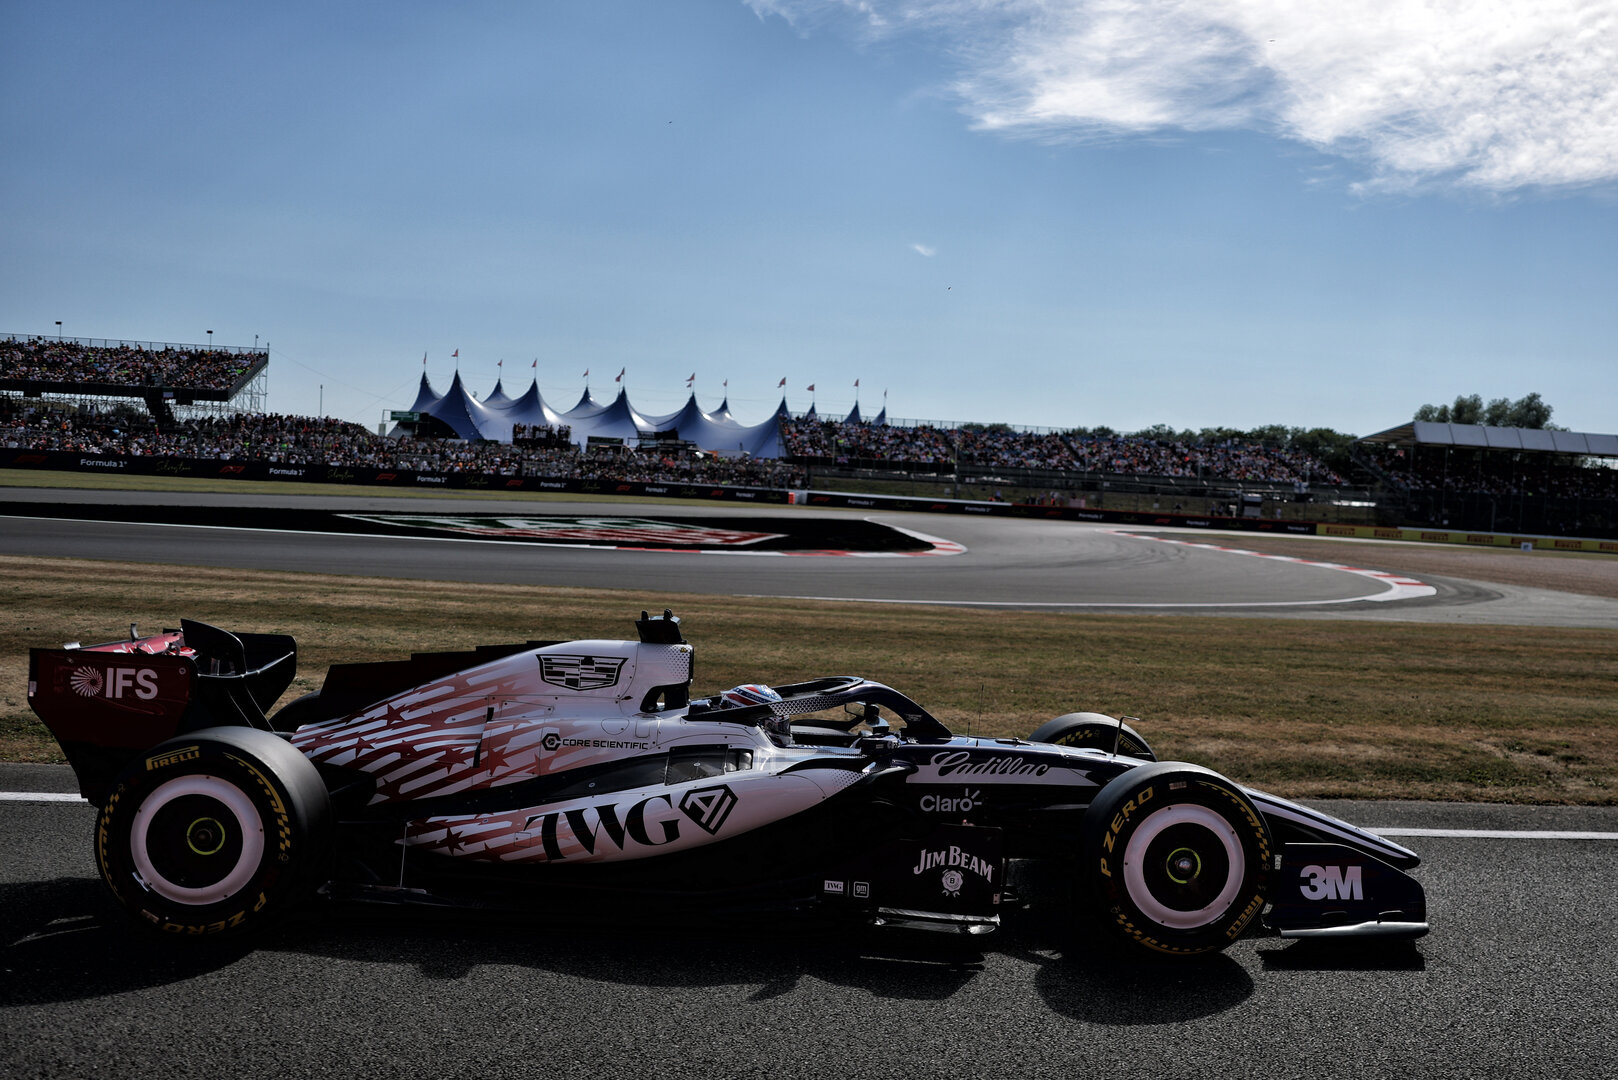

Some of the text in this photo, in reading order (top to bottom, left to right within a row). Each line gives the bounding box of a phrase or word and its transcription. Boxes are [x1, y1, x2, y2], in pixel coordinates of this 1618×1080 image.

[80, 458, 117, 467] Formula
[269, 467, 298, 476] Formula
[105, 667, 159, 700] IFS
[145, 745, 200, 771] PIRELLI
[562, 738, 649, 750] CORE SCIENTIFIC
[930, 751, 1049, 777] Cadillac
[523, 794, 680, 861] TWG
[1103, 785, 1155, 854] ZERO
[913, 845, 993, 884] JIM BEAM
[1100, 857, 1112, 878] P
[826, 882, 842, 890] TWG
[1300, 864, 1364, 901] 3M
[161, 891, 268, 936] P ZERO
[1226, 894, 1264, 940] PIRELLI
